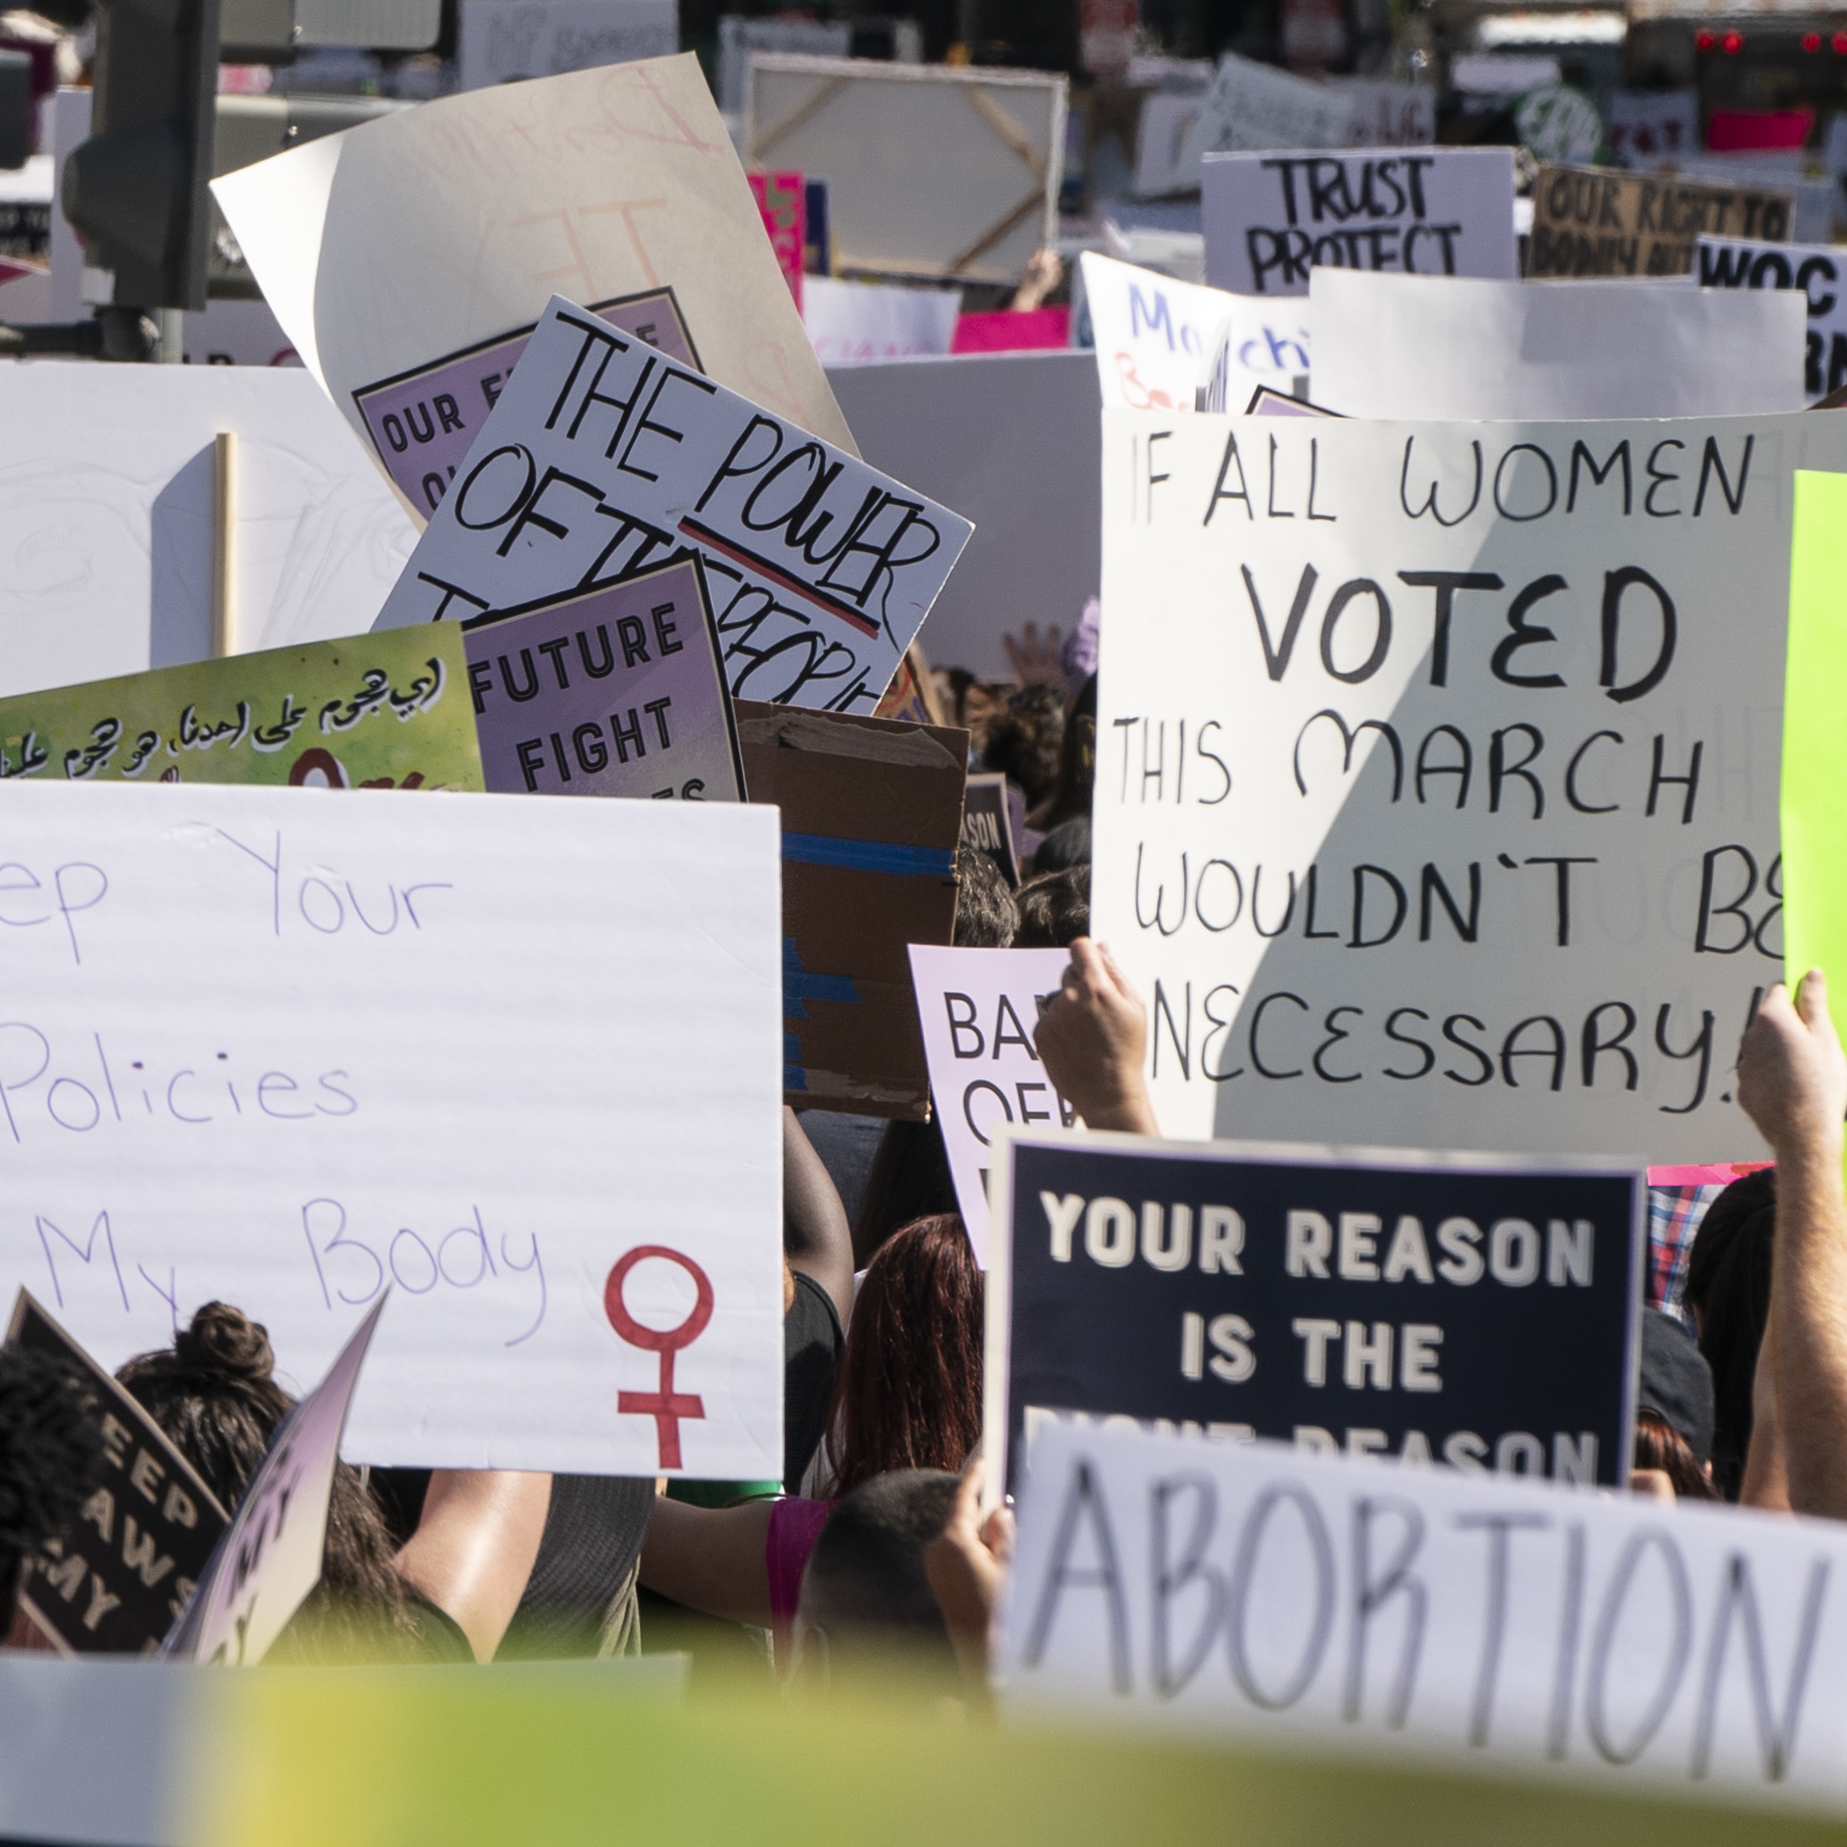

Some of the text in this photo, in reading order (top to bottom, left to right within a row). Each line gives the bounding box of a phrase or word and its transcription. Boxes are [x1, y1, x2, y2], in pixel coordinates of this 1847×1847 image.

[1261, 156, 1435, 228] TRUST
[1547, 174, 1621, 231] OUR
[1247, 221, 1461, 292] PROTECT
[380, 392, 464, 455] OUR
[456, 445, 606, 559] OF
[544, 311, 941, 654] THE POWER
[1204, 430, 1338, 527] ALL
[1400, 432, 1755, 527] WOMEN
[467, 601, 686, 715] FUTURE
[1239, 561, 1677, 705] VOTED
[518, 697, 673, 793] FIGHT
[1111, 708, 1705, 826] THIS MARCH
[216, 825, 455, 940] Your
[34, 1196, 548, 1348] My Body
[1039, 1190, 1596, 1290] YOUR REASON
[1179, 1310, 1444, 1394] IS THE
[1019, 1450, 1837, 1787] ABORTION
